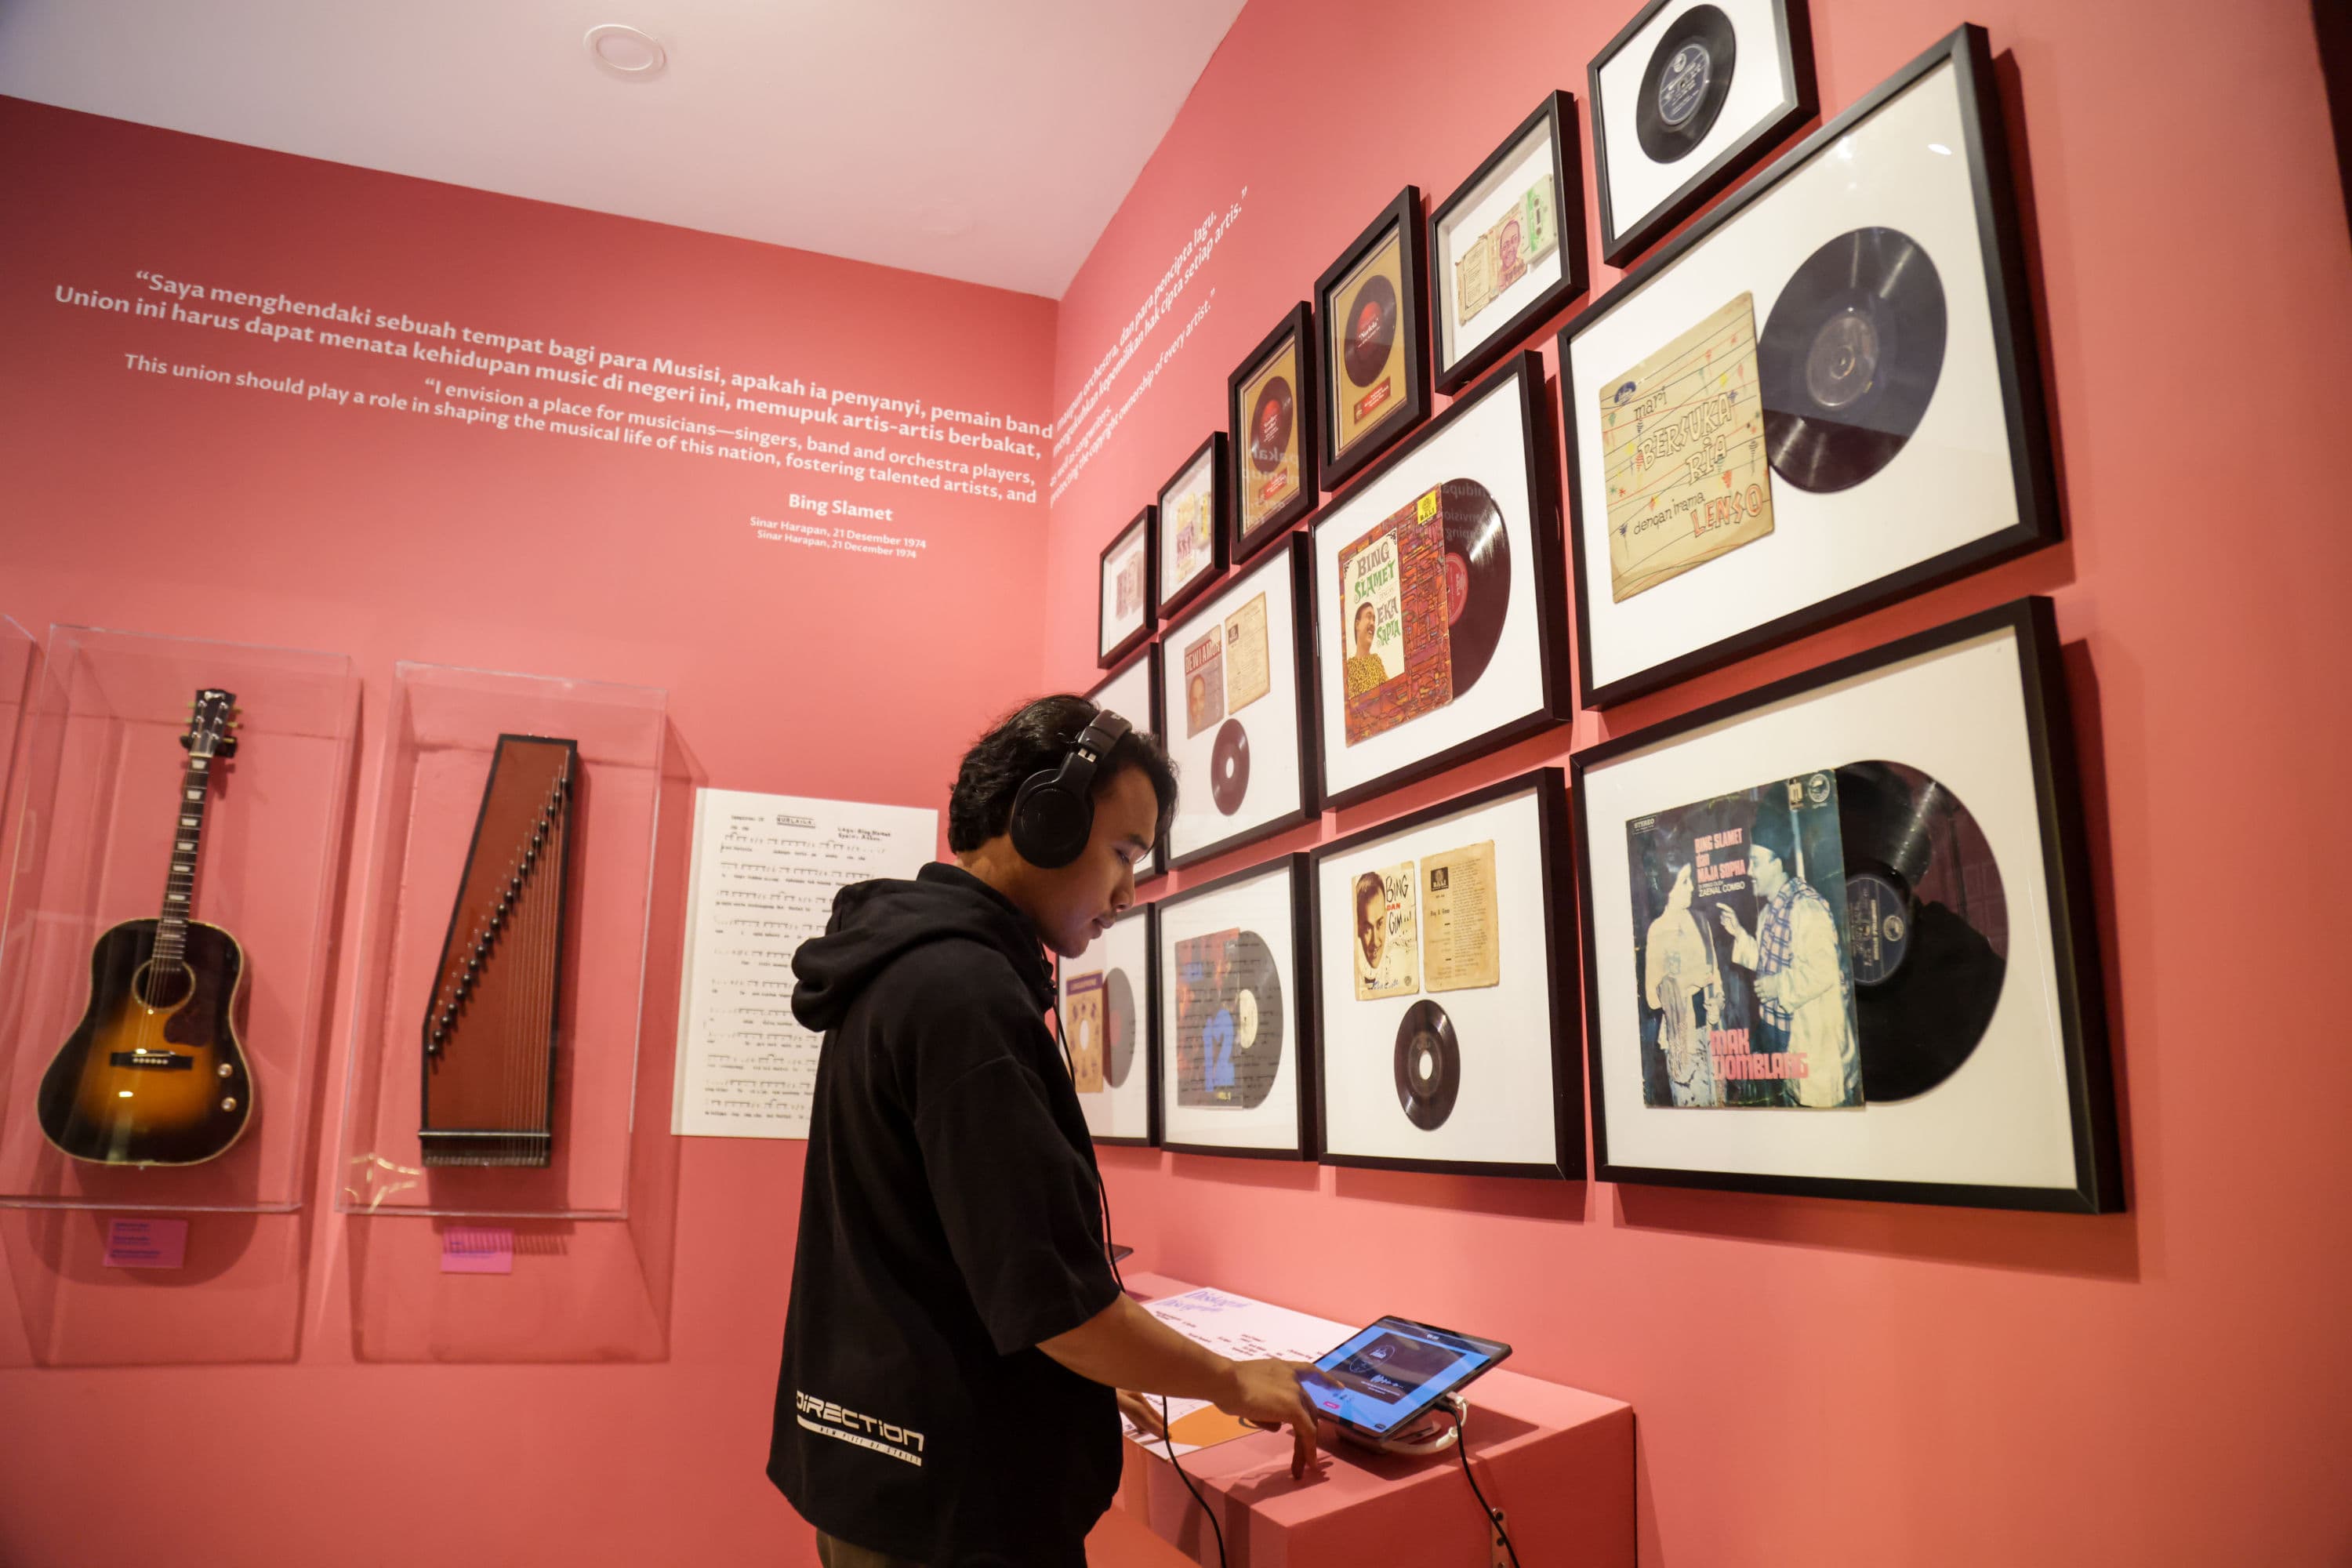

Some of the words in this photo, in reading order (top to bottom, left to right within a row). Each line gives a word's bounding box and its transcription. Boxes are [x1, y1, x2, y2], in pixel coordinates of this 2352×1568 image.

[1120, 327, 1134, 347] dan
[1135, 295, 1153, 331] para
[1155, 241, 1192, 304] pencipta
[1194, 212, 1216, 246] lagu.
[1145, 306, 1160, 337] hak
[1161, 278, 1183, 314] cipta
[1185, 238, 1214, 284] setiap
[55, 285, 129, 313] Union
[136, 297, 167, 319] ini
[171, 303, 240, 330] harus
[245, 316, 315, 343] dapat
[319, 332, 408, 358] menata
[412, 341, 530, 376] kehidupan
[535, 366, 599, 387] music
[603, 372, 624, 391] di
[627, 381, 695, 402] negeri
[699, 387, 731, 412] ini,
[736, 397, 838, 425] memupuk
[948, 426, 1041, 460] berbakat,
[210, 286, 372, 325] menghendaki
[375, 314, 456, 339] sebuah
[461, 327, 544, 354] tempat
[548, 339, 596, 365] bagi
[598, 352, 648, 371] para
[652, 358, 726, 387] Musisi,
[731, 374, 805, 396] apakah
[810, 381, 828, 400] ia
[831, 390, 927, 419] penyanyi,
[931, 406, 1001, 429] pemain
[1006, 415, 1054, 439] band
[1119, 370, 1154, 419] ownership
[1154, 352, 1164, 375] of
[1163, 330, 1185, 363] every
[1633, 391, 1668, 421] mari
[125, 353, 168, 374] This
[172, 364, 231, 384] union
[234, 371, 305, 395] should
[307, 383, 350, 405] play
[353, 392, 365, 404] a
[368, 393, 408, 410] role
[412, 397, 430, 414] in
[434, 401, 510, 430] shaping
[514, 412, 546, 430] the
[550, 421, 620, 442] musical
[623, 427, 652, 447] life
[656, 435, 678, 450] of
[680, 437, 714, 456] this
[718, 446, 781, 468] nation,
[786, 452, 866, 481] fostering
[869, 466, 941, 489] talented
[944, 478, 1004, 500] artists,
[1007, 489, 1037, 503] and
[445, 385, 524, 407] envision
[528, 397, 539, 409] a
[543, 397, 593, 417] place
[596, 404, 625, 422] for
[807, 435, 850, 456] band
[853, 447, 886, 461] and
[889, 452, 969, 474] orchestra
[972, 463, 1036, 486] players,
[1638, 392, 1732, 470] BERSUKA
[789, 493, 829, 516] Bing
[832, 500, 894, 521] Slamet
[1690, 483, 1764, 538] LENSO
[750, 516, 779, 528] Sinar
[780, 521, 830, 538] Harapan,
[833, 528, 845, 538] 21
[847, 530, 902, 546] Desember
[903, 538, 927, 549] 1974
[757, 529, 783, 540] Sinar
[785, 533, 830, 549] Harapan,
[831, 540, 844, 550] 21
[844, 541, 894, 555] December
[895, 548, 916, 558] 1974
[1357, 541, 1390, 579] BING
[1354, 559, 1396, 604] SLAMET
[1377, 597, 1399, 626] EKA
[1694, 835, 1713, 853] BING
[1714, 828, 1742, 849] SLAMET
[1386, 874, 1409, 903] BING
[1386, 903, 1401, 912] DAN
[1699, 885, 1722, 898] ZAENAL
[1722, 880, 1745, 892] COMBO
[1710, 1028, 1751, 1054] MAK
